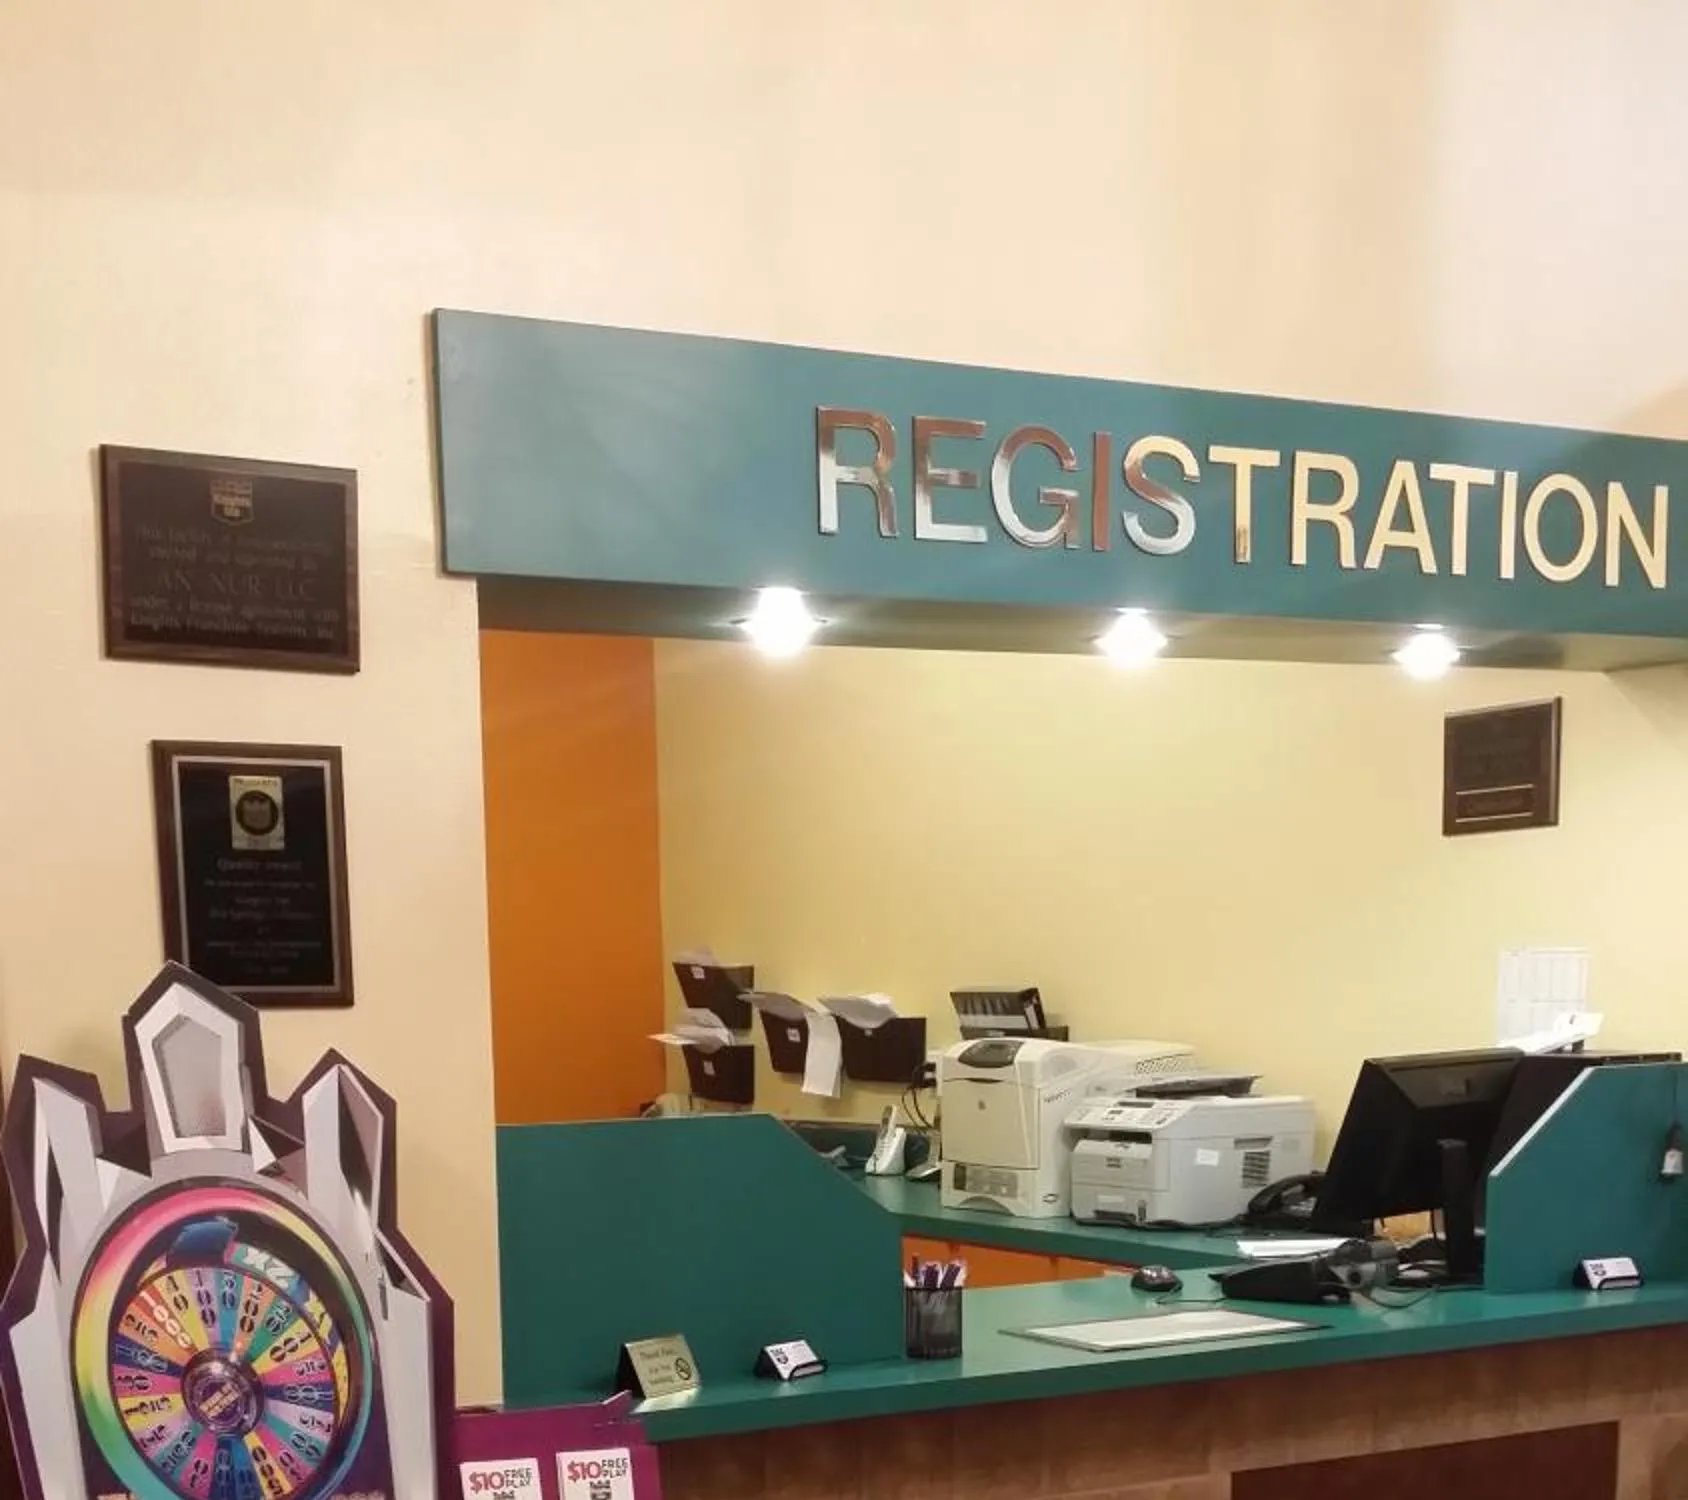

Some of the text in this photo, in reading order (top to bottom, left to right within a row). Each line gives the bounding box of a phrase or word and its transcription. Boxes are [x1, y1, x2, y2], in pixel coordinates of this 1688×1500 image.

[815, 404, 1670, 589] REGISTRATION
[139, 1290, 192, 1349] 1000
[469, 1467, 533, 1494] $10 FREE
[567, 1458, 628, 1483] $10 FREE
